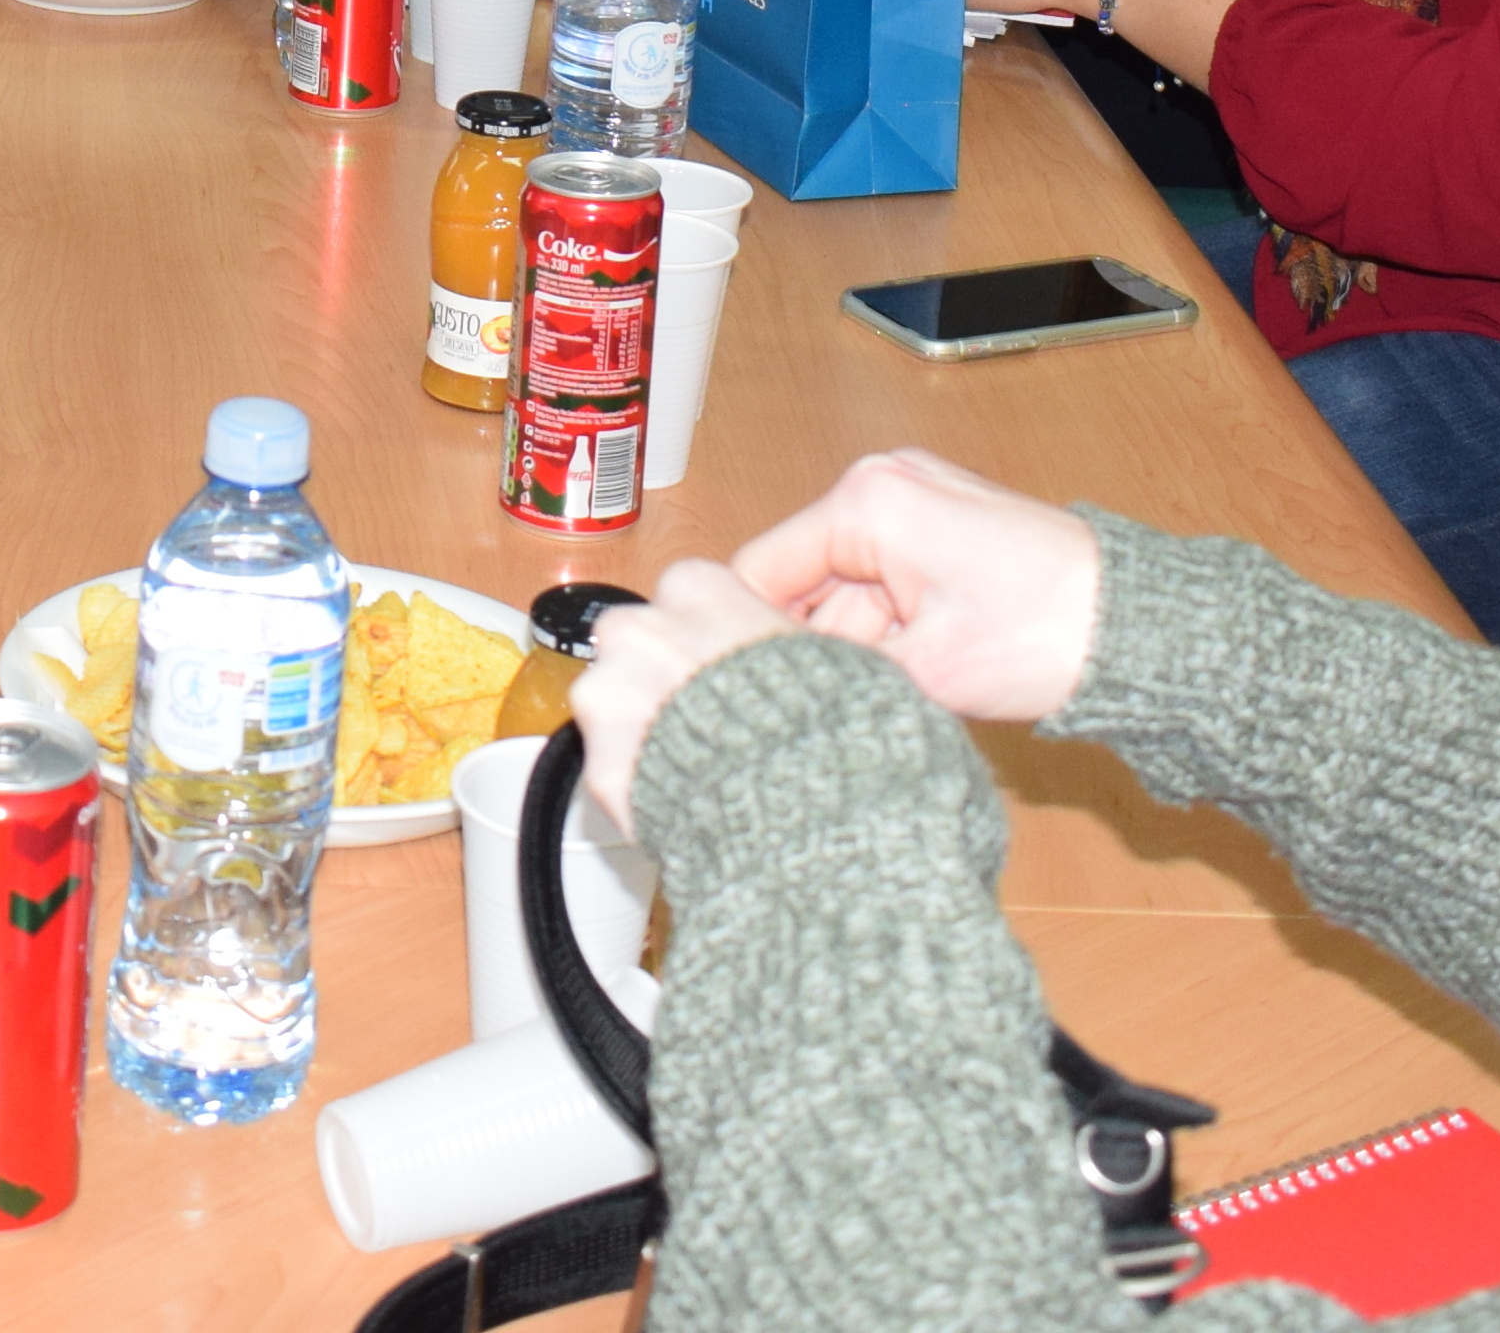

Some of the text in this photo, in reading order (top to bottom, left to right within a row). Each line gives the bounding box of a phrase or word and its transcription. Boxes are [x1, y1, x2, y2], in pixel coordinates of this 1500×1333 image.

[538, 231, 597, 261] Coke
[550, 257, 585, 275] 330 ml
[434, 301, 481, 338] GUSTO
